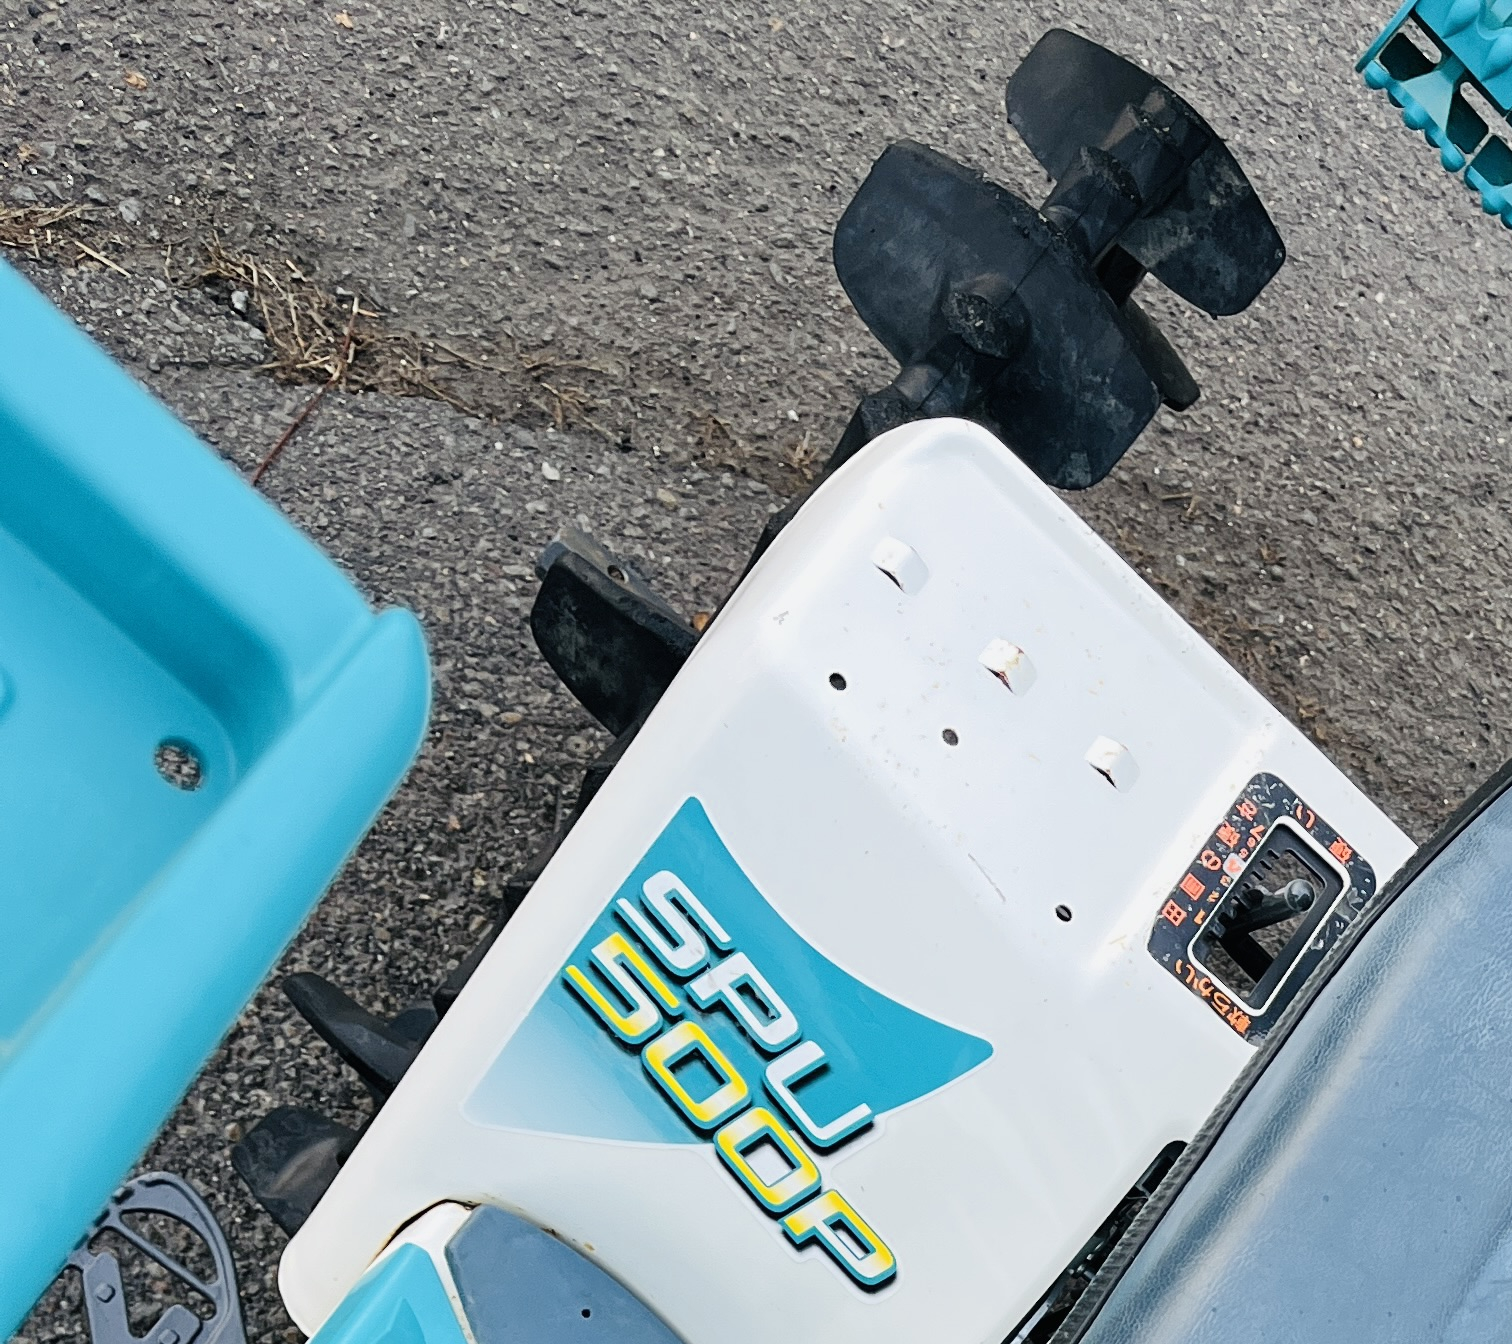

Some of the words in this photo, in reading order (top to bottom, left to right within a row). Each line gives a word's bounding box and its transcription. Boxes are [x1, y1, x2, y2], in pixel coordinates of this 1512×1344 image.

[563, 932, 898, 1287] 500P
[613, 869, 875, 1148] SPU
[1175, 959, 1251, 1034] 軟らかい
